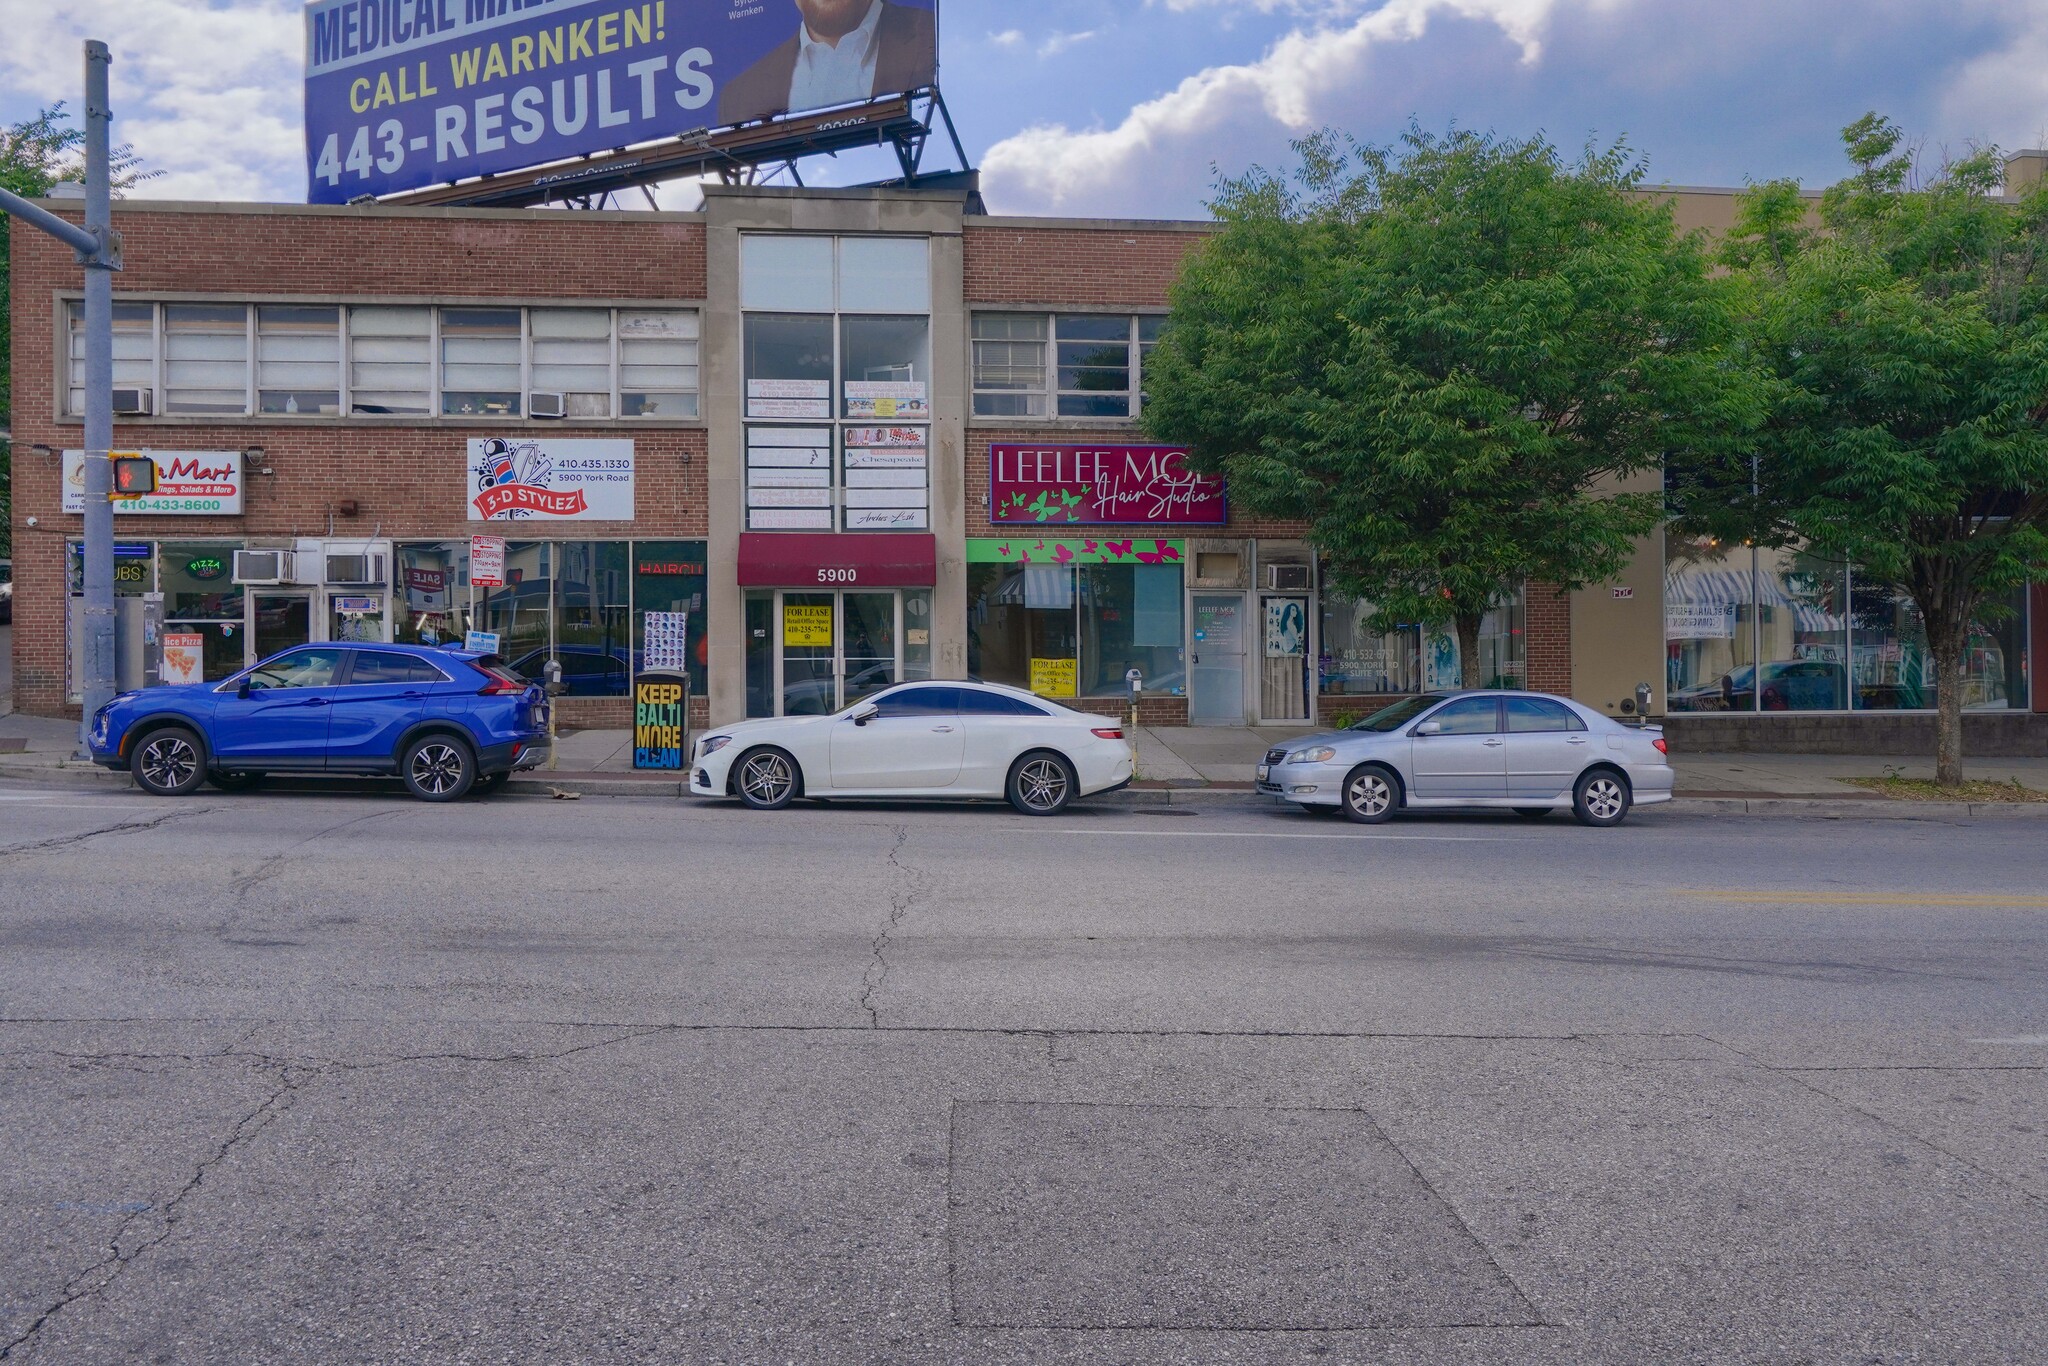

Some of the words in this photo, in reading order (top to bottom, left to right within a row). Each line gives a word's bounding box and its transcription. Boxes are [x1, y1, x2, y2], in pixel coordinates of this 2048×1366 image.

[734, 0, 758, 8] Byro
[728, 5, 764, 20] Warnken
[314, 0, 456, 67] MEDICAL
[350, 61, 438, 114] CALL
[450, 1, 666, 89] WARNKEN!
[315, 46, 714, 187] 443-RESULTS
[558, 459, 630, 469] 410.435.1330
[861, 456, 923, 464] Chesapeake
[168, 457, 236, 481] Mart
[998, 451, 1111, 483] LEELEE
[558, 474, 582, 482] 5900
[584, 474, 604, 482] York
[606, 474, 629, 482] Road
[179, 485, 203, 494] Salads
[205, 485, 211, 494] &
[212, 485, 232, 494] More
[1092, 471, 1146, 519] Hair
[1145, 473, 1210, 519] Studio
[487, 489, 513, 511] 3-D
[517, 488, 576, 511] STYLEZ
[120, 500, 220, 511] 410-433-8600
[474, 537, 481, 545] NO
[481, 538, 502, 546] STOPPING
[481, 551, 502, 560] STOPPING
[190, 560, 220, 571] PIZZA
[818, 569, 856, 582] 5900
[787, 608, 802, 616] FOR
[804, 608, 829, 616] LEASE
[164, 636, 180, 646] lice
[181, 636, 201, 646] Pizza
[1051, 661, 1074, 669] LEASE
[1362, 661, 1384, 669] YORK
[1350, 669, 1372, 677] SUITE
[1375, 669, 1389, 677] 100
[637, 684, 682, 704] KEEP
[637, 704, 681, 727] BALTI
[637, 726, 681, 749] MORE
[635, 747, 681, 769] CLEAN
